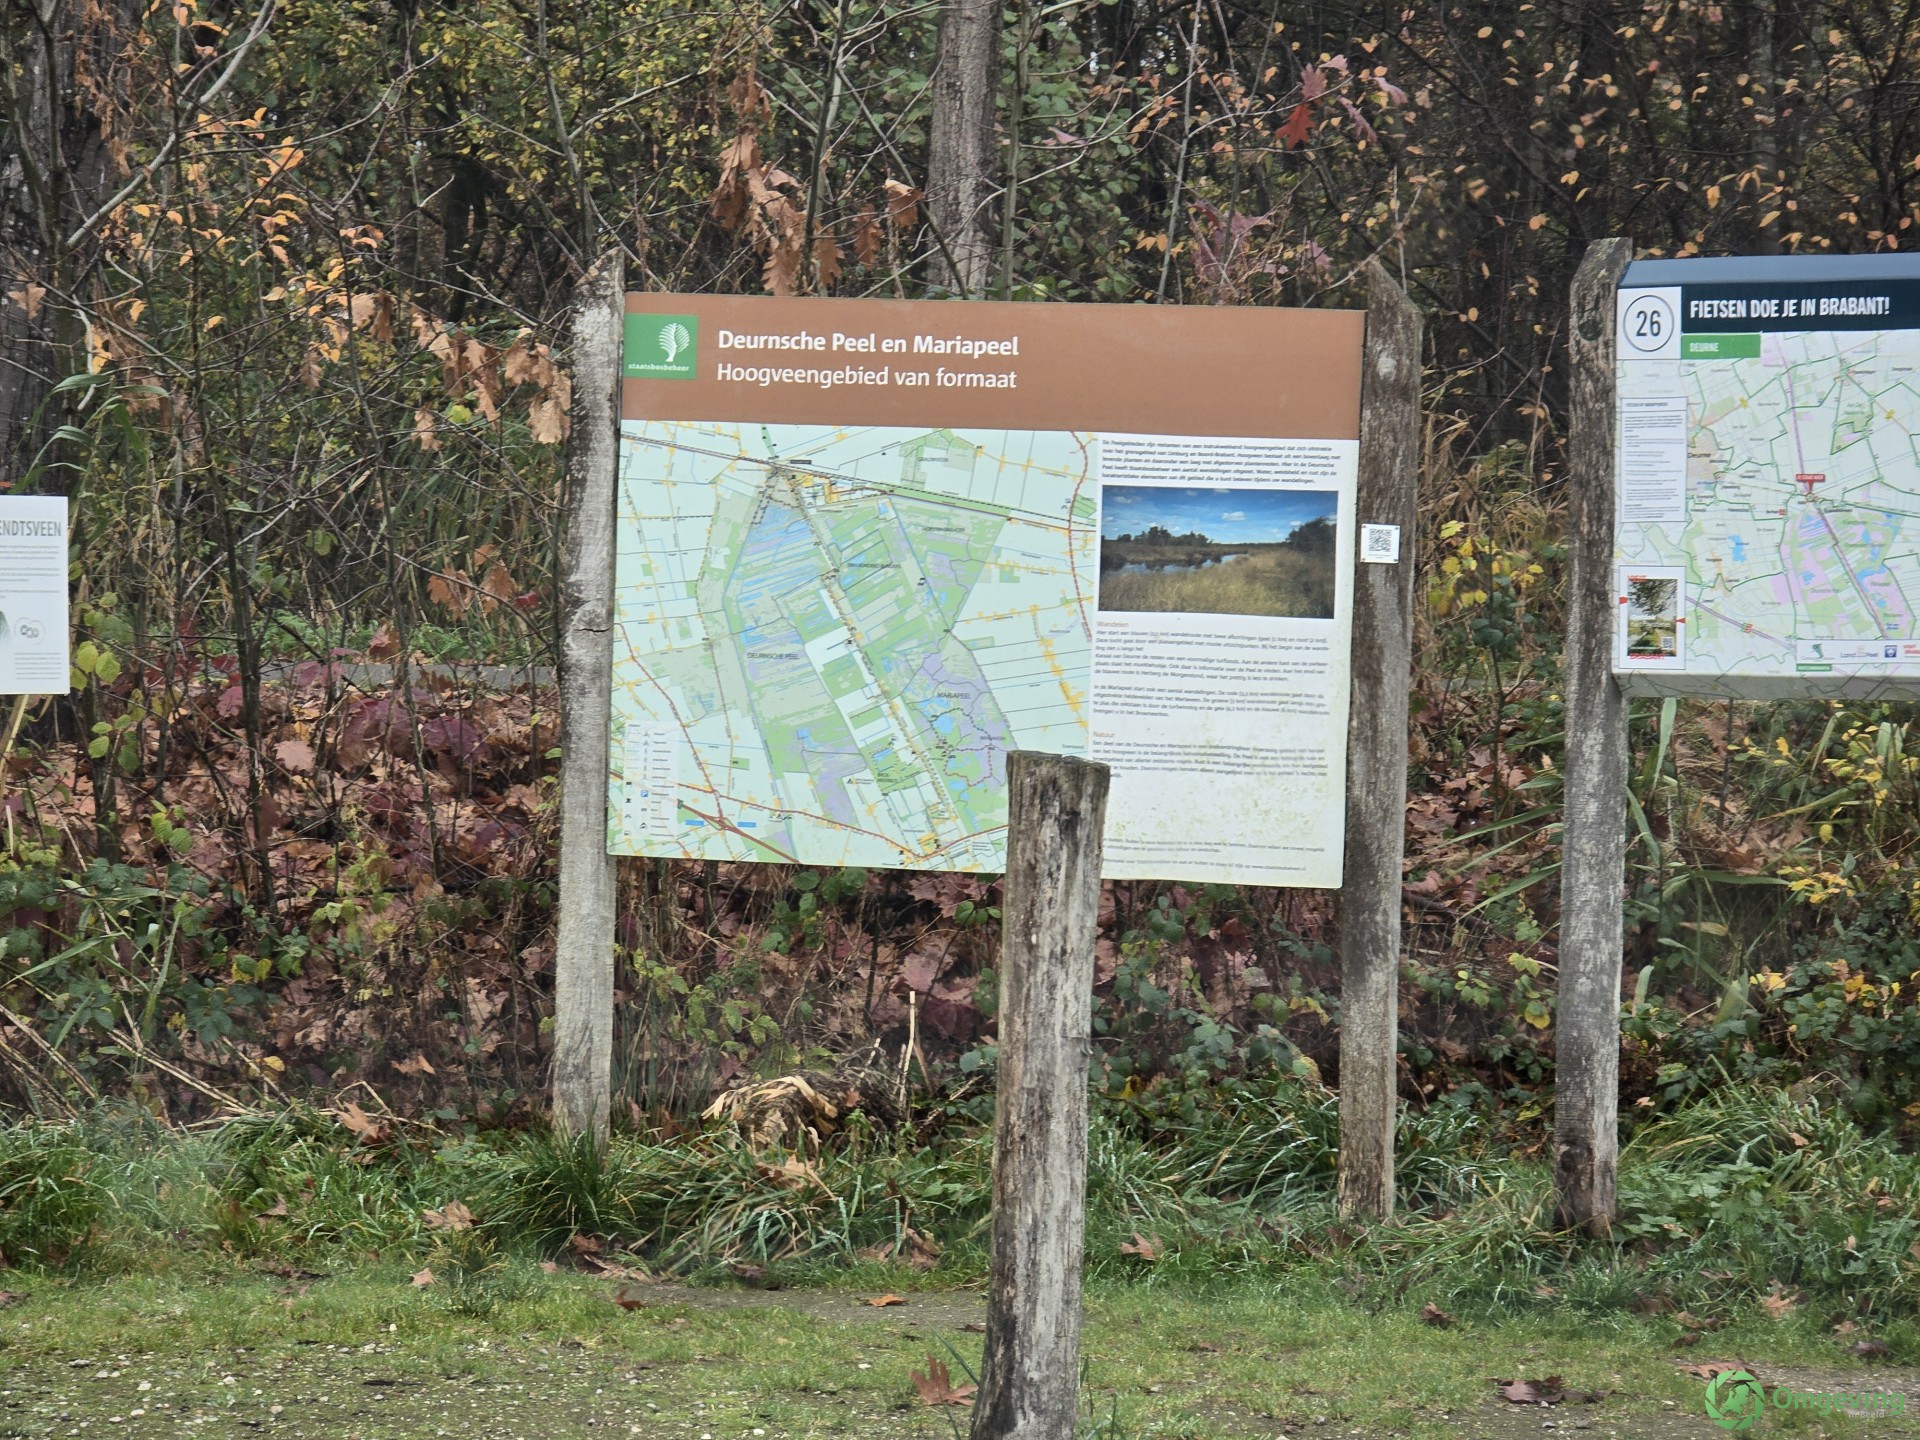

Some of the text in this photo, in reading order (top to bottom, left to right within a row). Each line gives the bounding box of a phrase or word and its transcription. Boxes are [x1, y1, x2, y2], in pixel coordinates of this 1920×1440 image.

[1690, 297, 1890, 318] FIETSEN DOE JE IN BRABANT!
[1636, 310, 1661, 337] 26
[718, 330, 1019, 359] Deurnsche Peel en Mariapeel
[1690, 342, 1719, 352] DEURNE
[628, 363, 690, 372] staatsbosbeheer
[717, 363, 1017, 388] Hoogveengebied van formaat
[0, 520, 62, 537] NDTSVEEN
